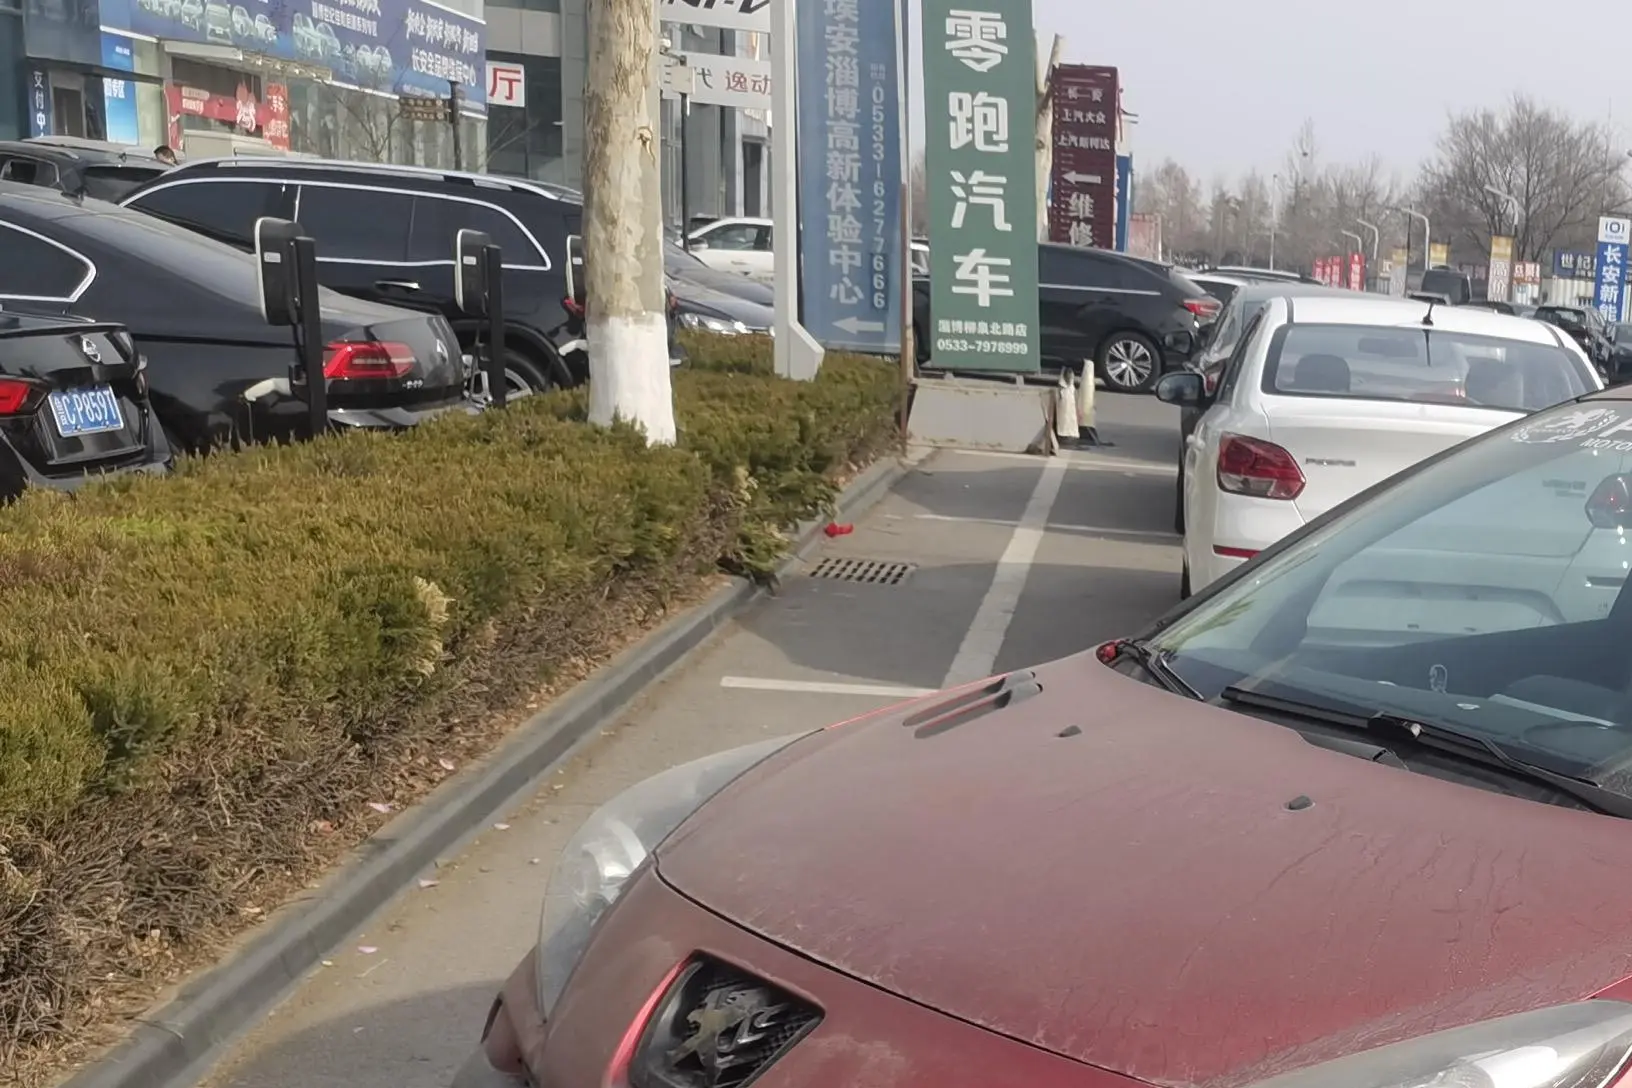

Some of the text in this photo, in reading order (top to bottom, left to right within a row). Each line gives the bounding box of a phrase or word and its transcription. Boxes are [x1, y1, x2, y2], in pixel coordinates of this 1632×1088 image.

[33, 71, 46, 137] 交付中
[489, 67, 522, 101] 厅
[725, 70, 771, 96] 逸动
[945, 9, 1014, 307] 零跑汽车
[1067, 192, 1095, 248] 维修
